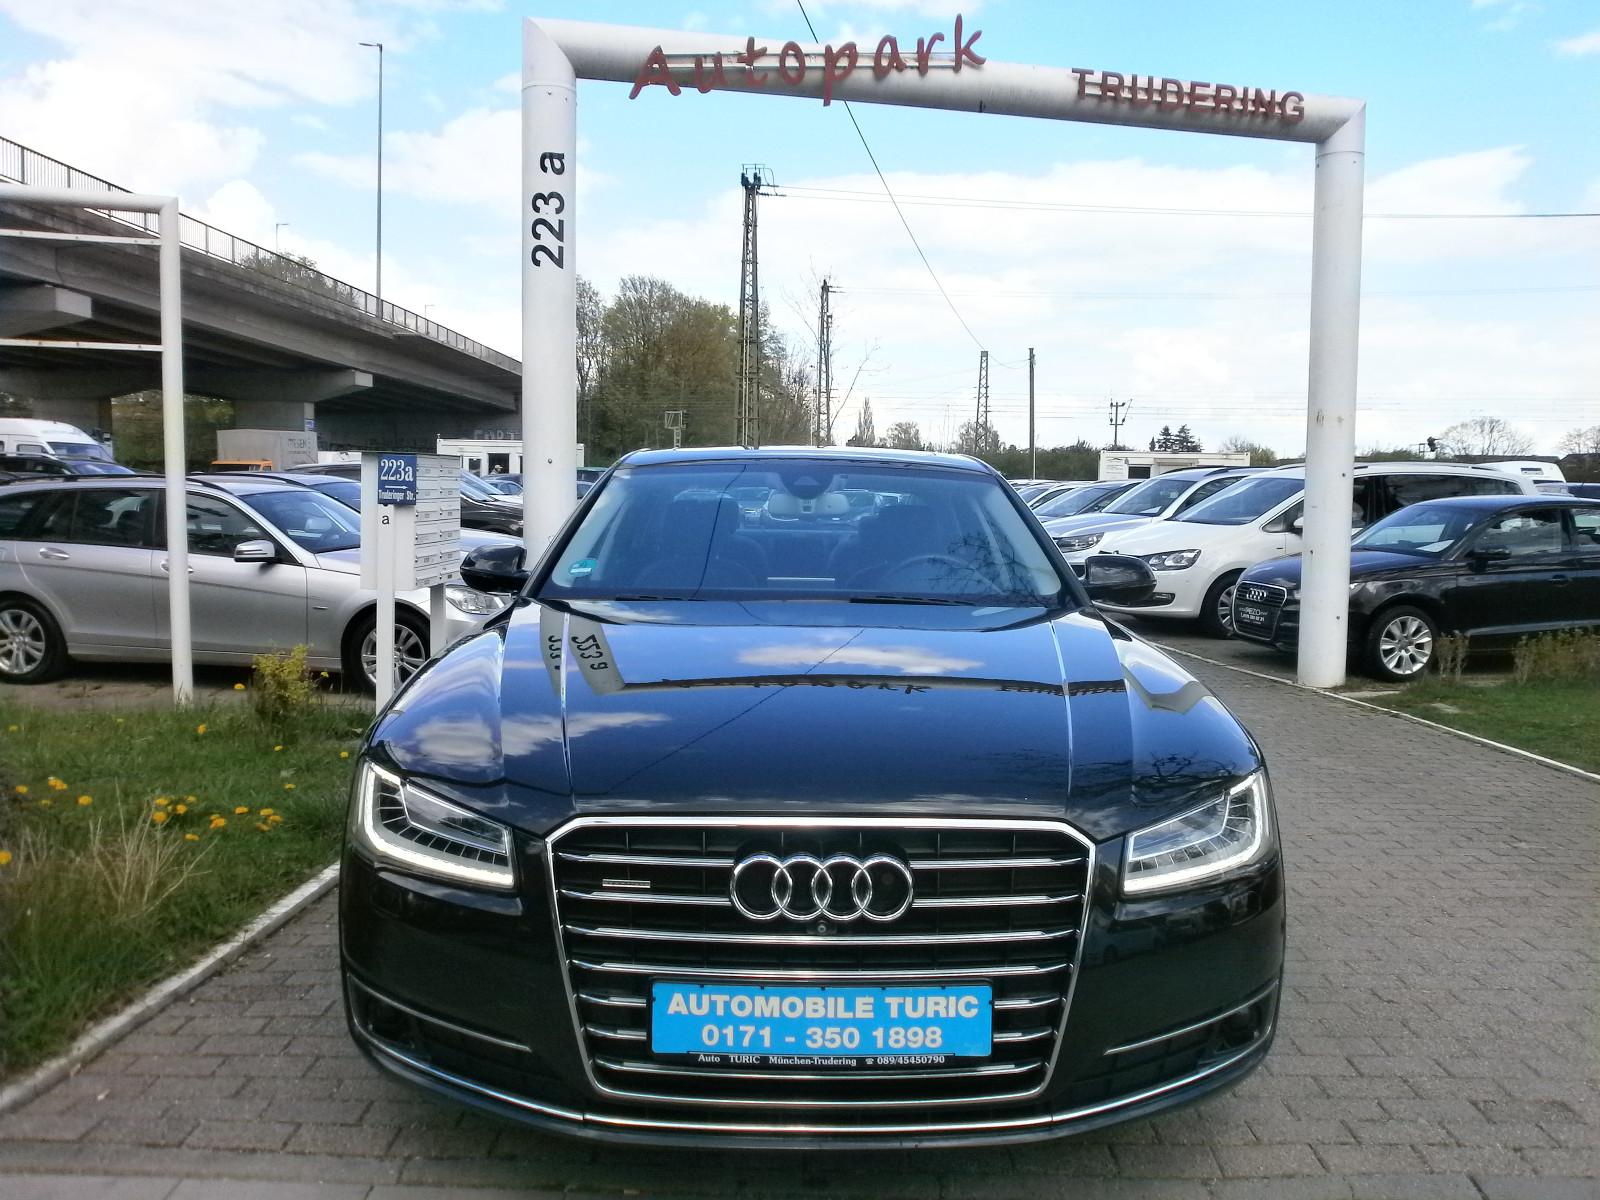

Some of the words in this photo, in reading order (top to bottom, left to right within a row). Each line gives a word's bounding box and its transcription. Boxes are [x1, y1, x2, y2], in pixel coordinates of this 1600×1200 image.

[628, 14, 986, 106] Autopark
[1072, 68, 1305, 122] TRUDERING
[540, 151, 565, 175] a
[531, 191, 565, 270] 223
[381, 459, 413, 482] 223a
[382, 515, 390, 525] a
[667, 993, 874, 1020] AUTOMOBILE
[885, 996, 979, 1019] TURIC
[702, 1024, 772, 1048] 0171
[806, 1026, 860, 1050] 350
[872, 1026, 942, 1049] 1898
[698, 1054, 721, 1063] Auto
[728, 1055, 760, 1064] TURIC
[769, 1055, 857, 1067] München-Trudering
[877, 1055, 946, 1065] 089/45450790
